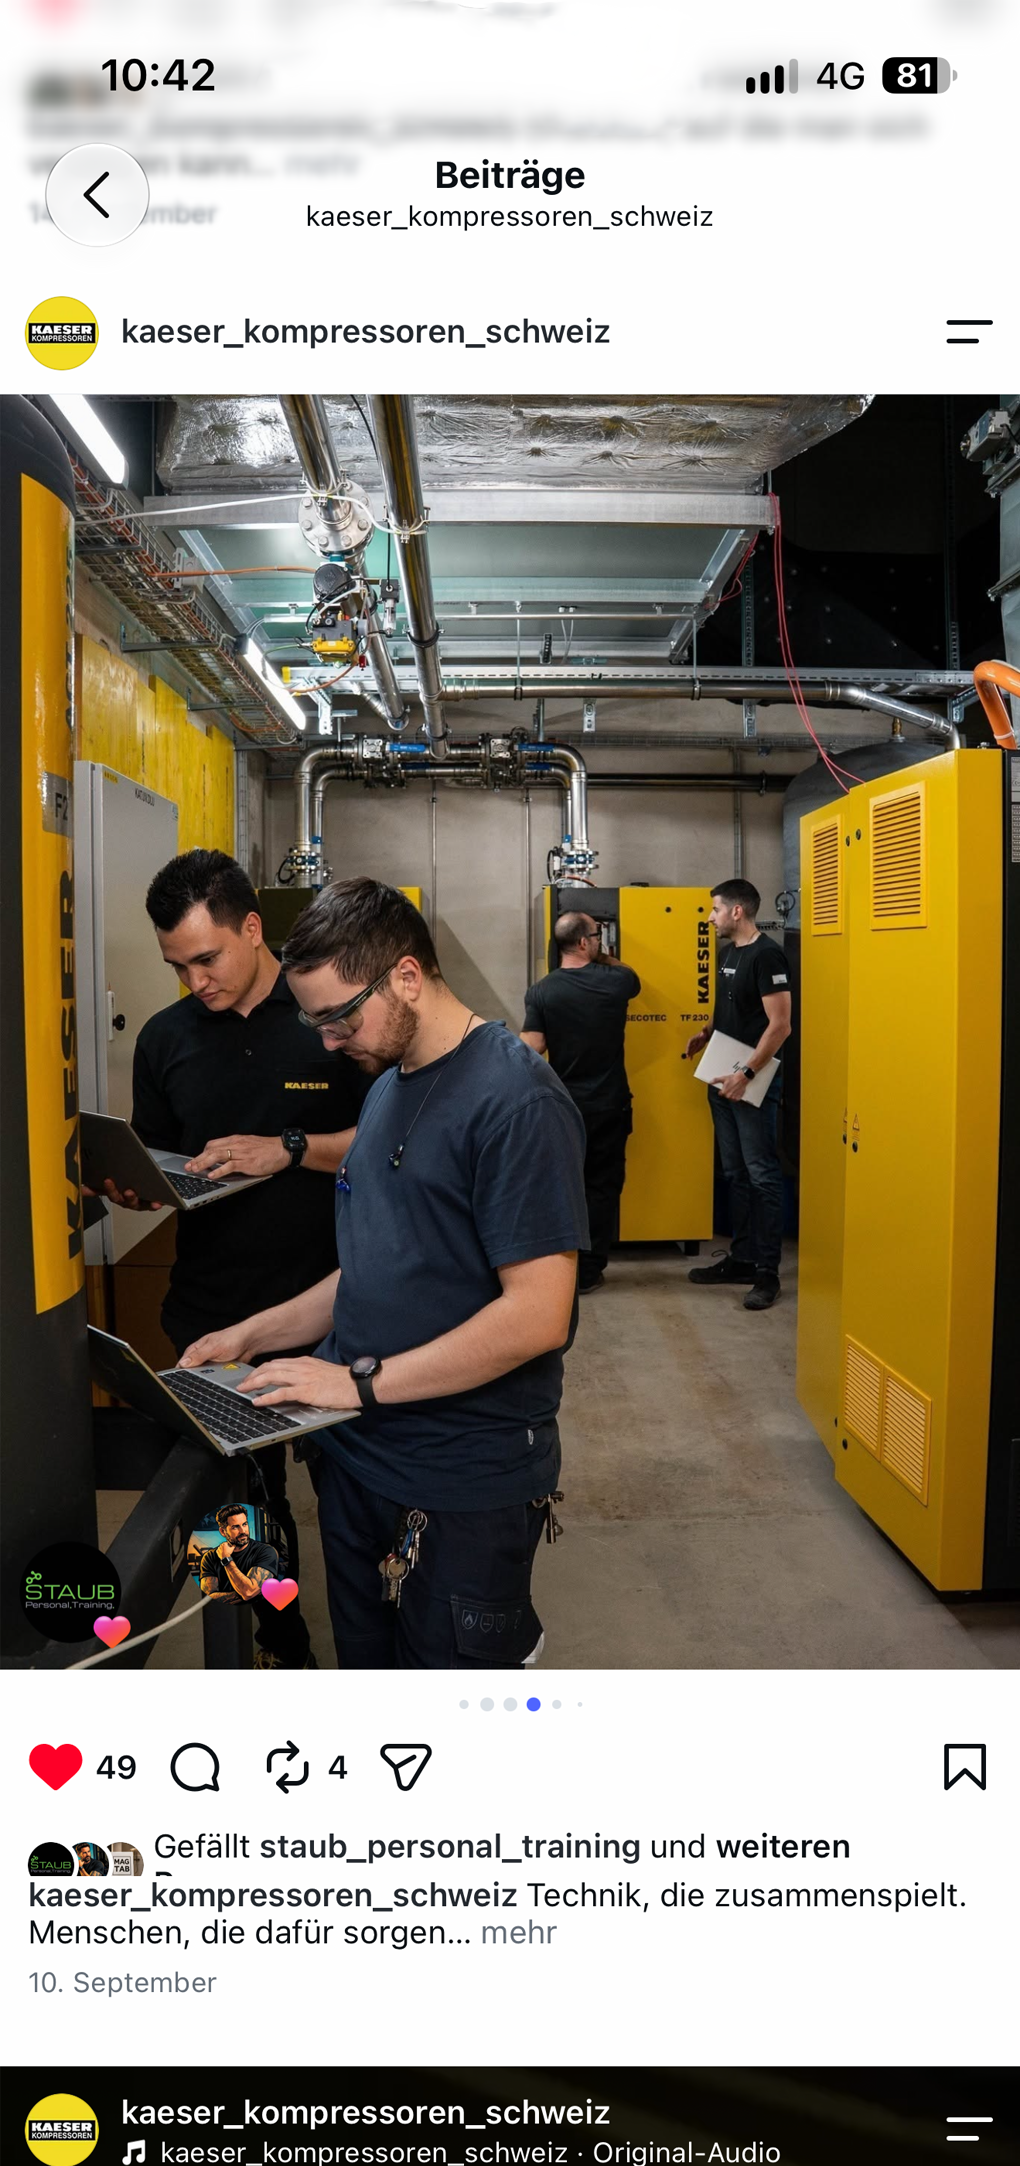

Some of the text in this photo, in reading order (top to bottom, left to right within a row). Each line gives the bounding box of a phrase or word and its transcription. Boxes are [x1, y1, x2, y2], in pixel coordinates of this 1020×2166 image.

[55, 792, 69, 821] F2
[697, 920, 710, 1004] KAESER
[625, 1014, 709, 1022] SECOTEC TF 230
[59, 870, 83, 1260] KAESER
[284, 1082, 330, 1090] KAESER
